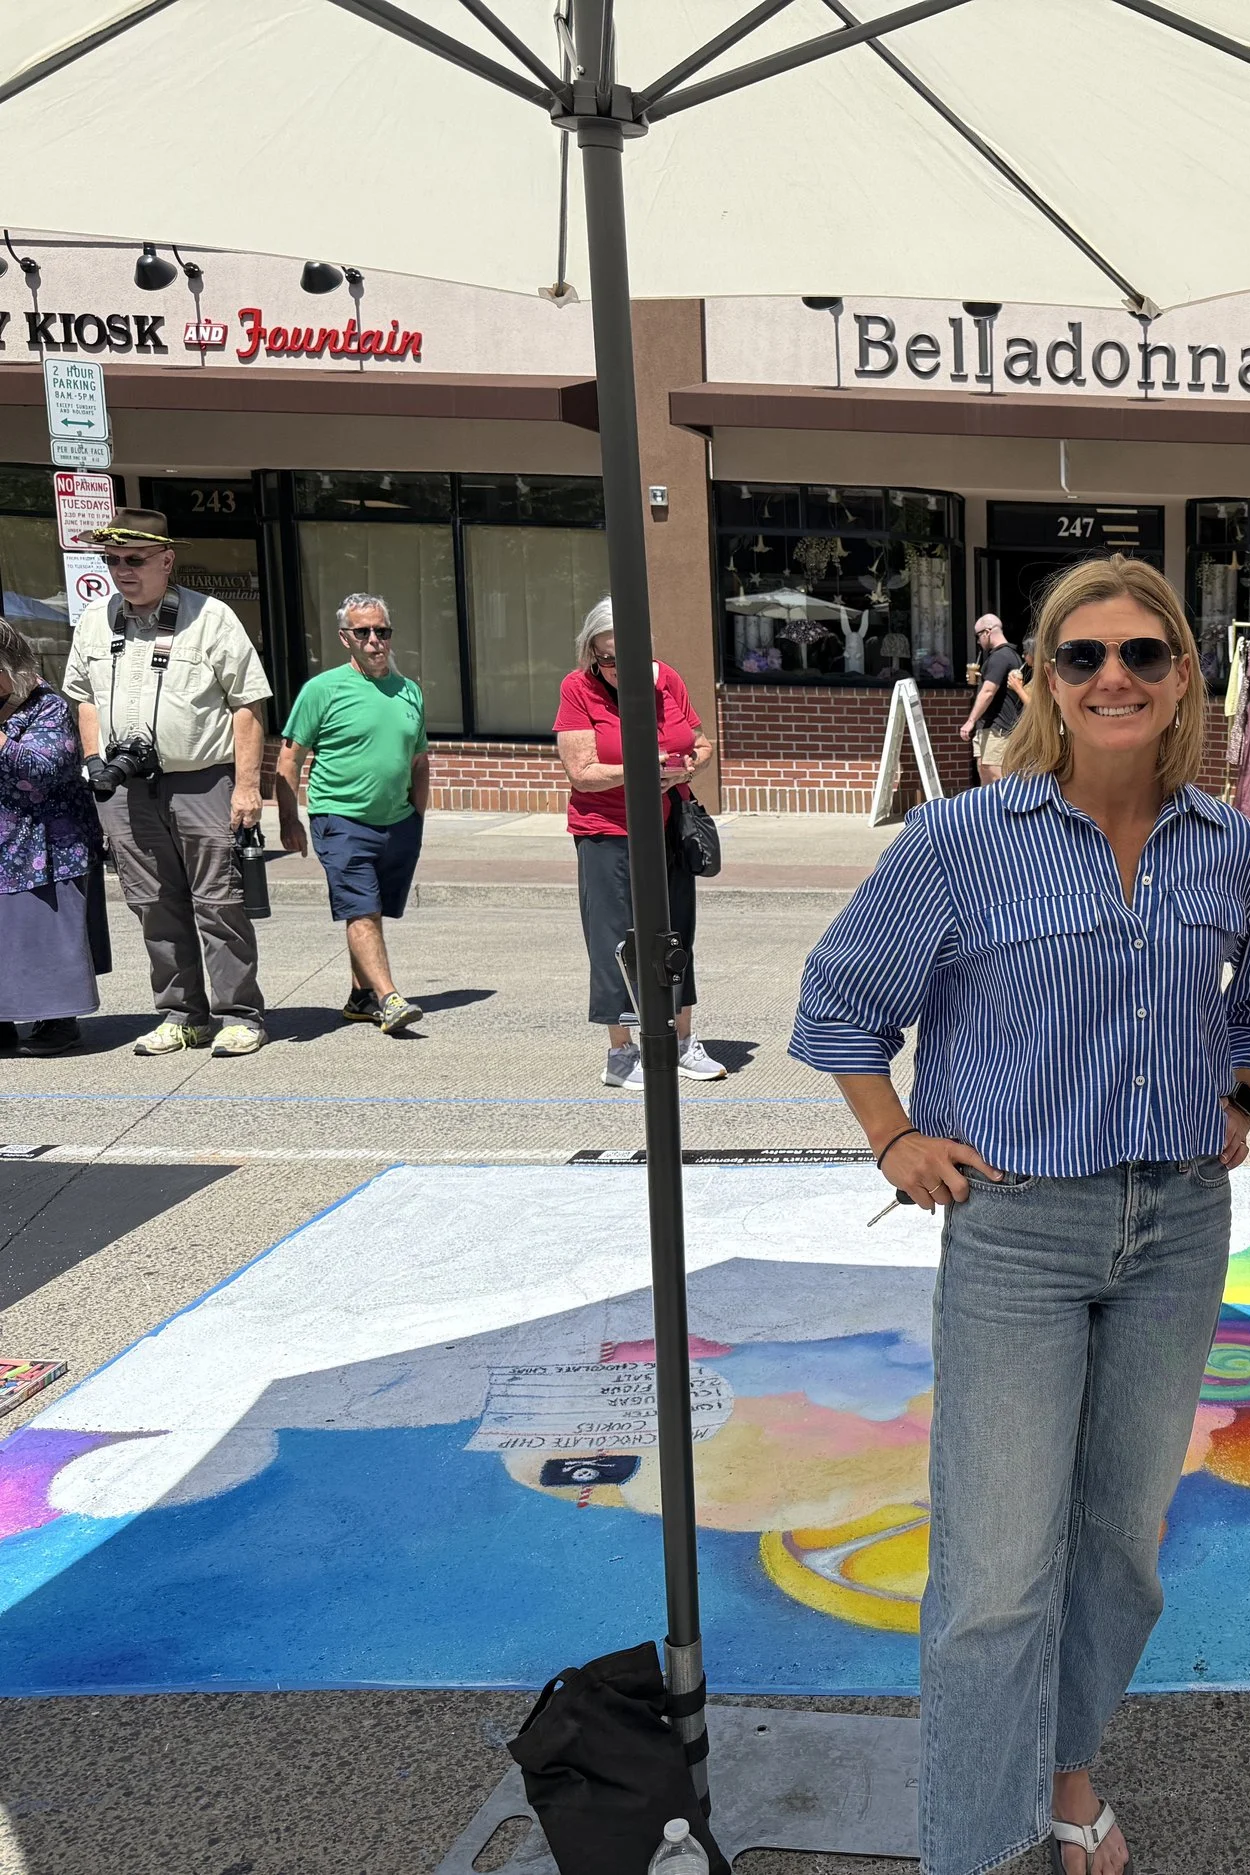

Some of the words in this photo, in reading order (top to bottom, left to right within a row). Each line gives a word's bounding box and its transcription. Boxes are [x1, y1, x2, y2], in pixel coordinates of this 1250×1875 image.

[24, 311, 168, 349] KIOSK
[185, 326, 225, 343] AND
[236, 308, 423, 358] Fountain
[52, 365, 59, 376] 2
[66, 366, 94, 379] HOUR
[52, 377, 97, 391] PARKING
[57, 477, 74, 492] NO
[75, 480, 109, 493] PARKING
[61, 498, 110, 511] TUESDAYS
[191, 490, 236, 513] 243
[1057, 516, 1095, 538] 247
[179, 575, 248, 588] PHARMACY
[606, 1395, 657, 1407] UGAR
[500, 1437, 546, 1450] CHIP
[553, 1434, 658, 1449] CHOCOLATE
